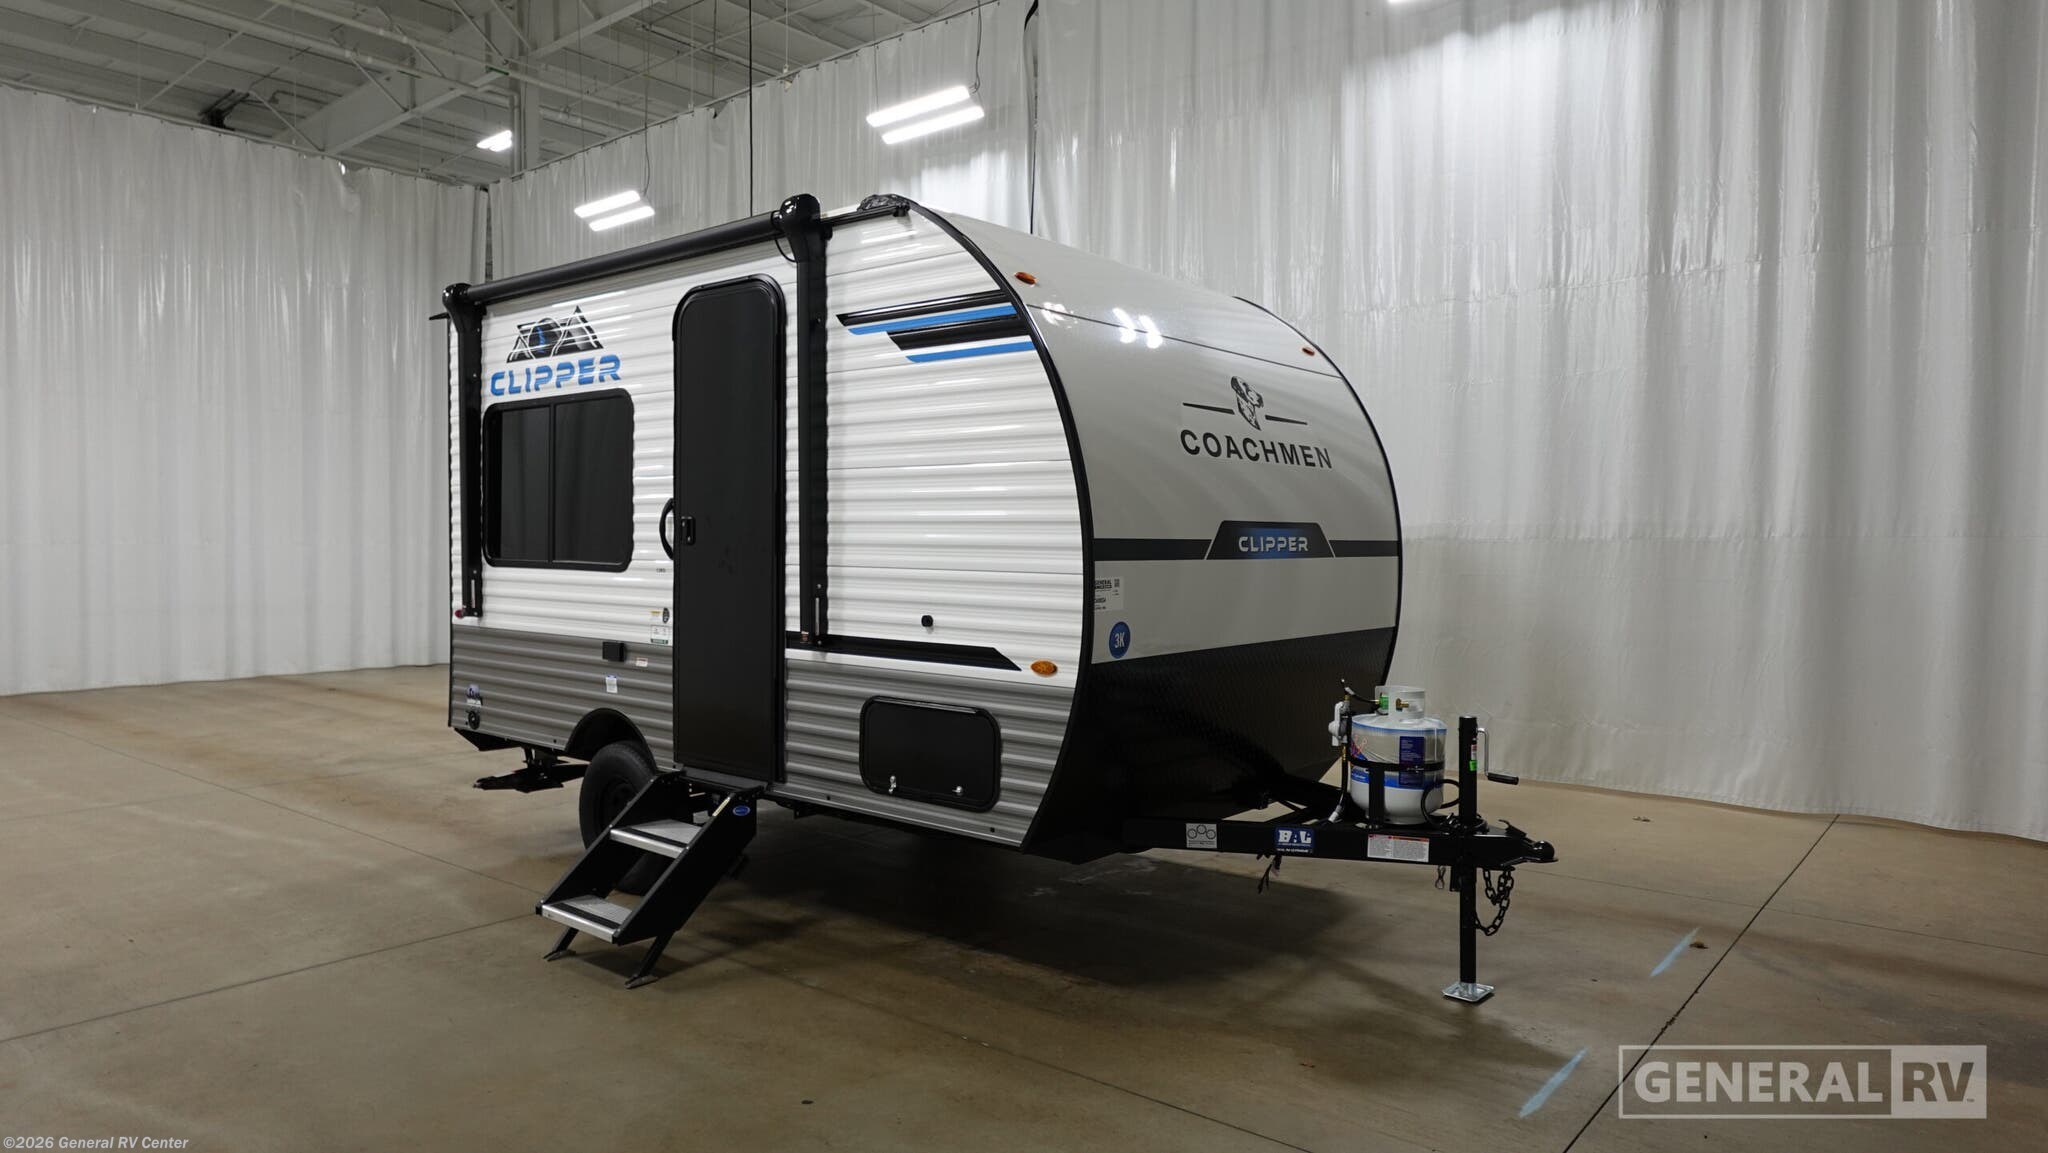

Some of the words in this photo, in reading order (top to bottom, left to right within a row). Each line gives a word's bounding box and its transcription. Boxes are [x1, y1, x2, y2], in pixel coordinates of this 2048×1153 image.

[490, 354, 621, 396] CLIPPER
[1180, 429, 1332, 469] COACHMEN
[1238, 536, 1309, 553] CLIPPER
[1114, 632, 1125, 649] 3K
